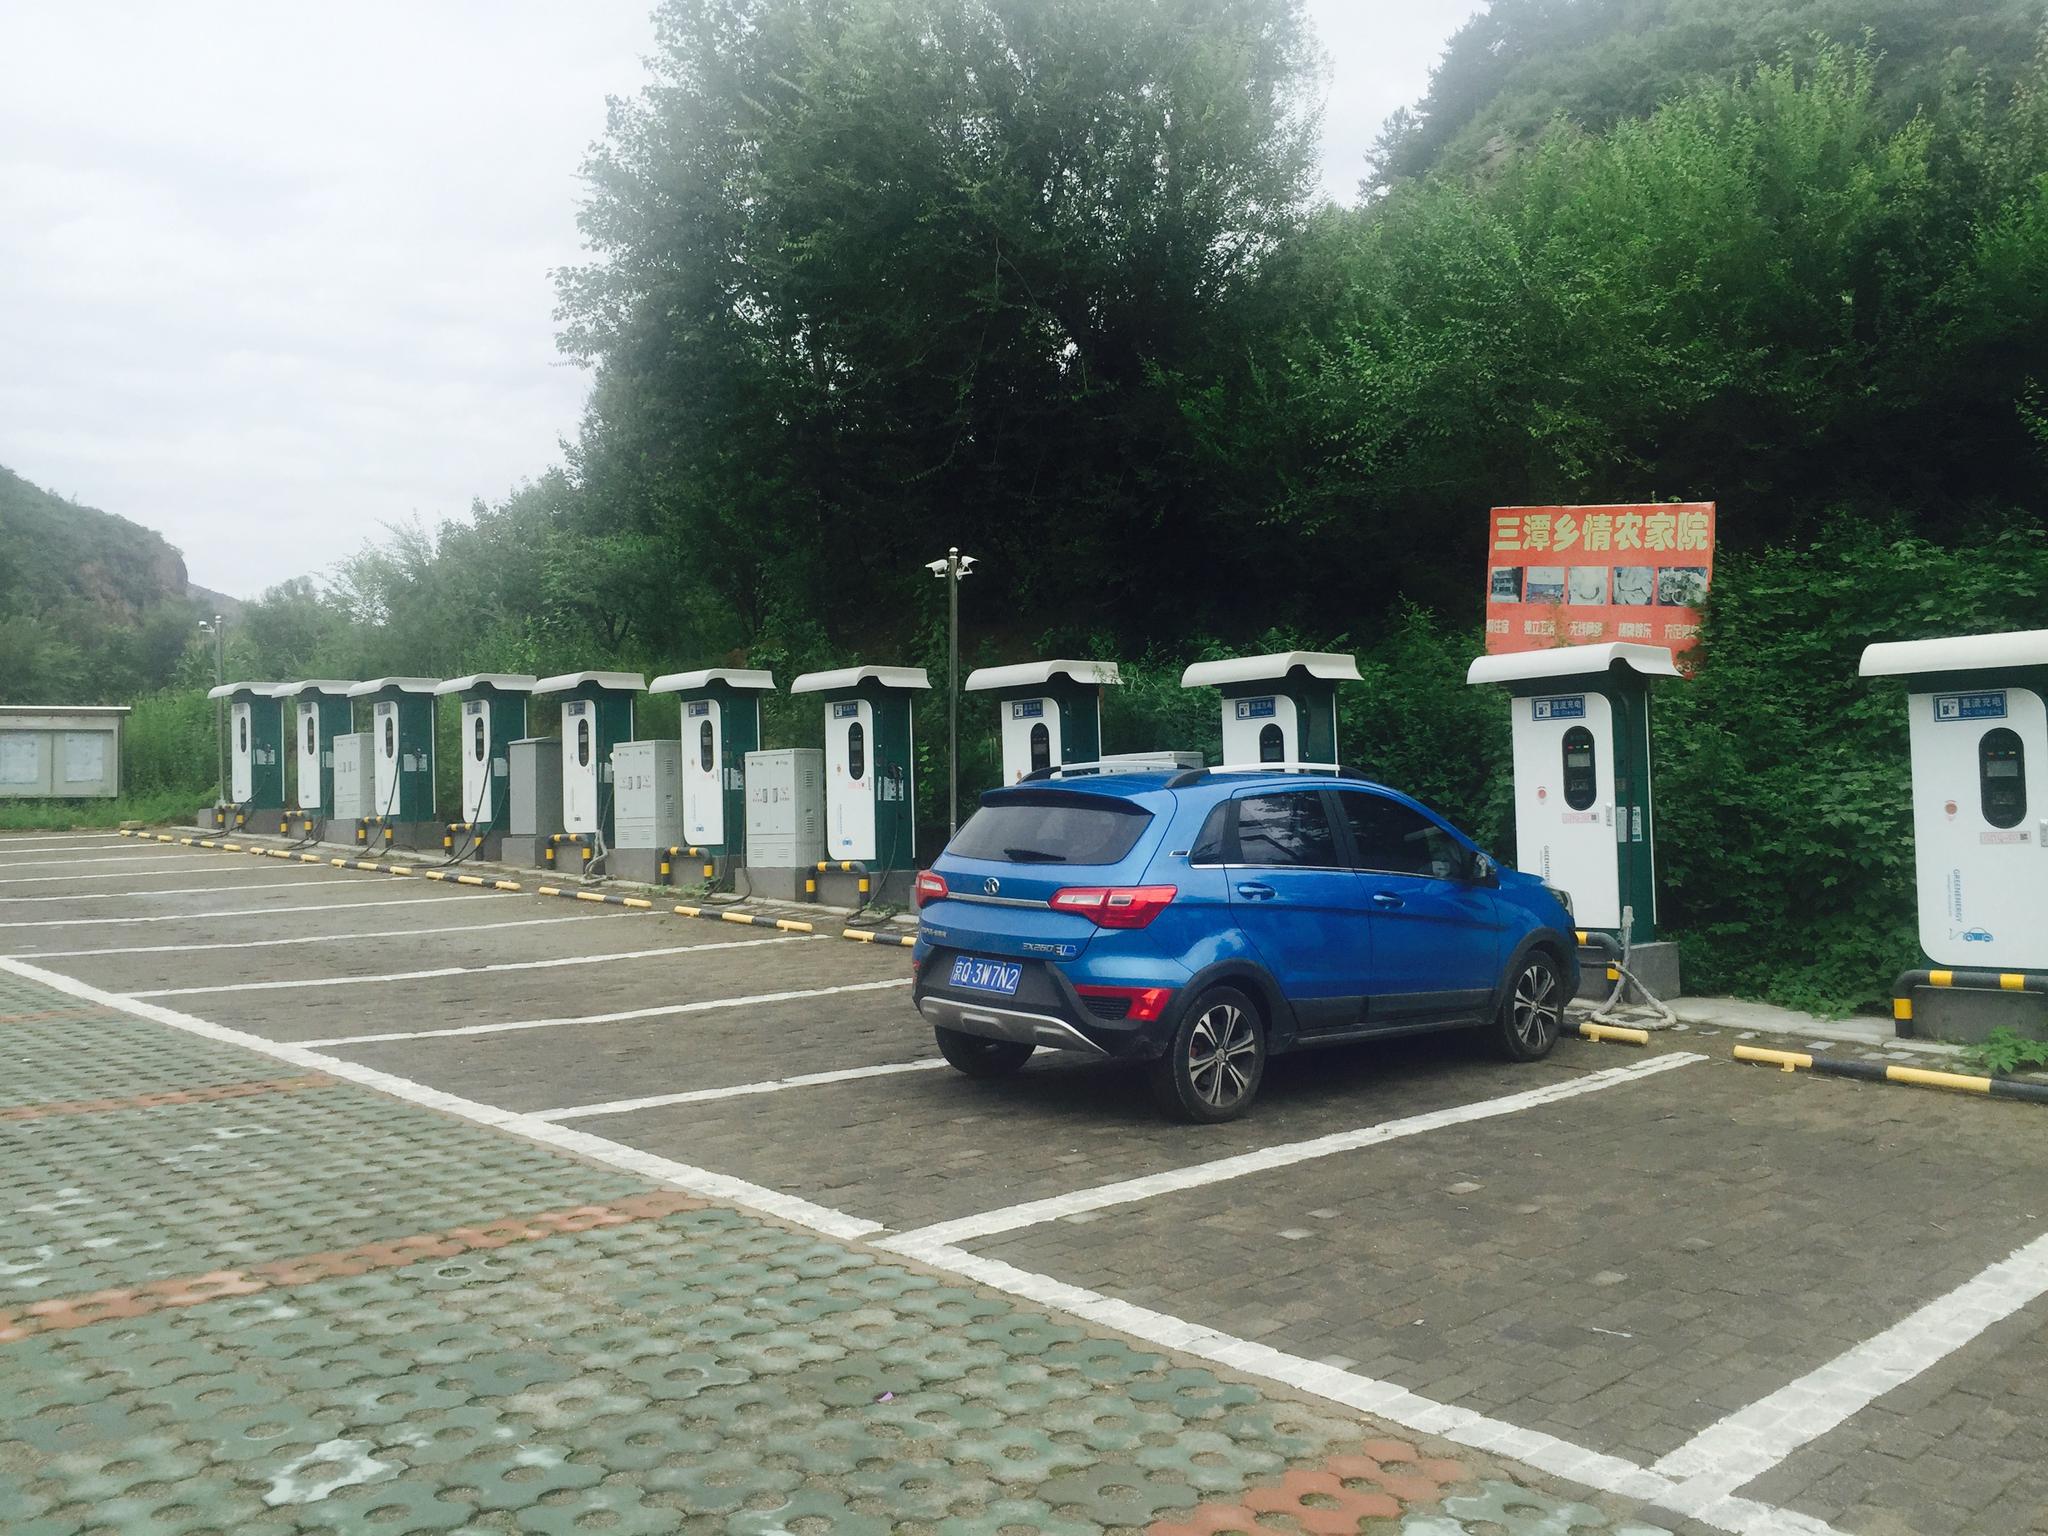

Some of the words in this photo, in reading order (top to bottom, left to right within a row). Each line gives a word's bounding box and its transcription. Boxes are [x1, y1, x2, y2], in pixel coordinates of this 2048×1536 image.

[1494, 512, 1709, 551] 三潭乡情农家院
